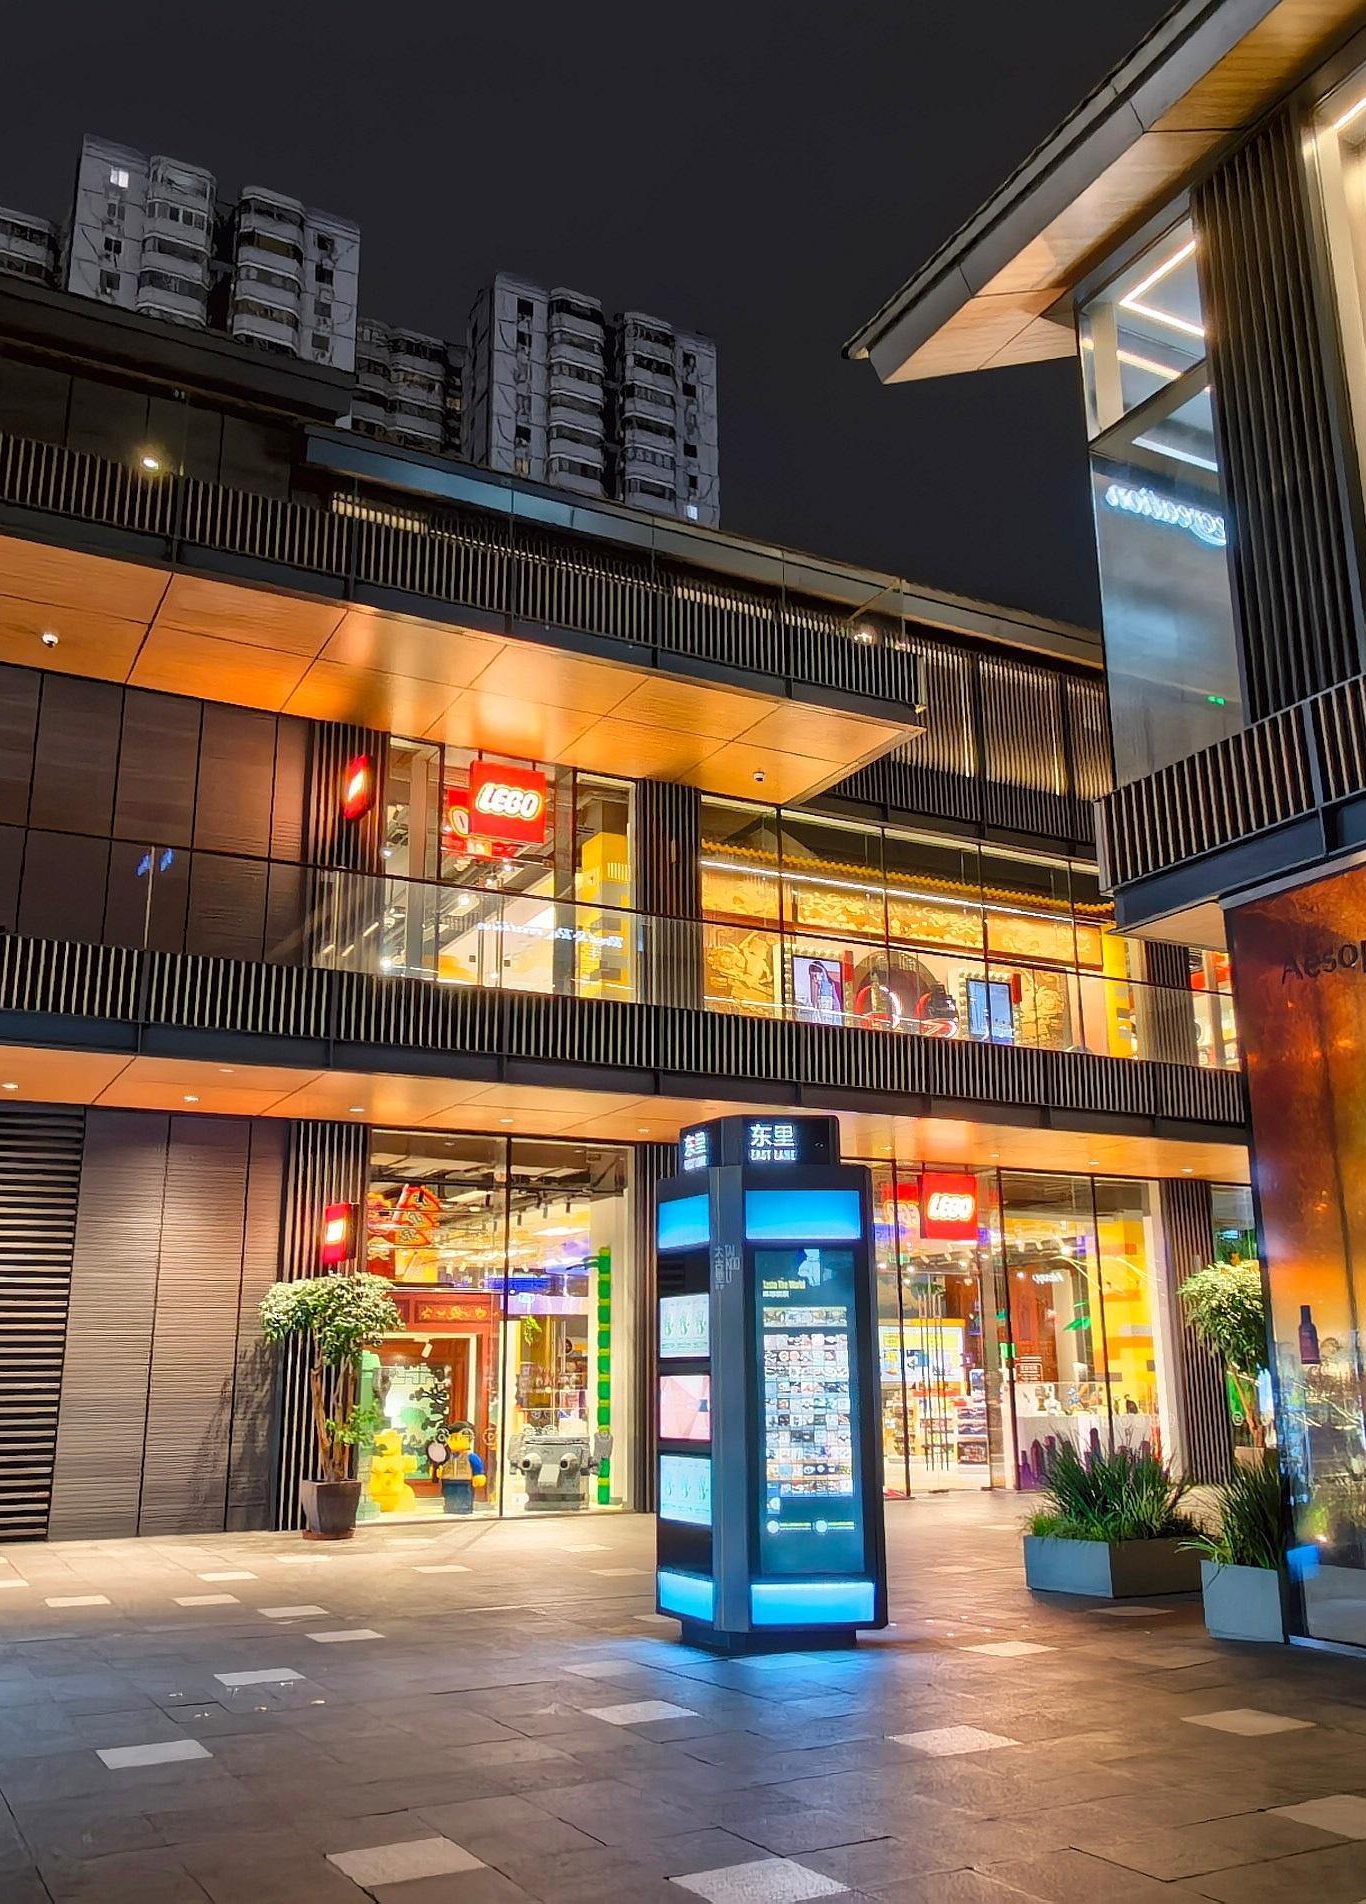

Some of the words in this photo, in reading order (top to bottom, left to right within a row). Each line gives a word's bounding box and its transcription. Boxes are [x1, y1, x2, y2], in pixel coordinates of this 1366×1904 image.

[476, 783, 540, 820] LEGO
[749, 1124, 795, 1147] 东里
[928, 1193, 974, 1221] LEGO
